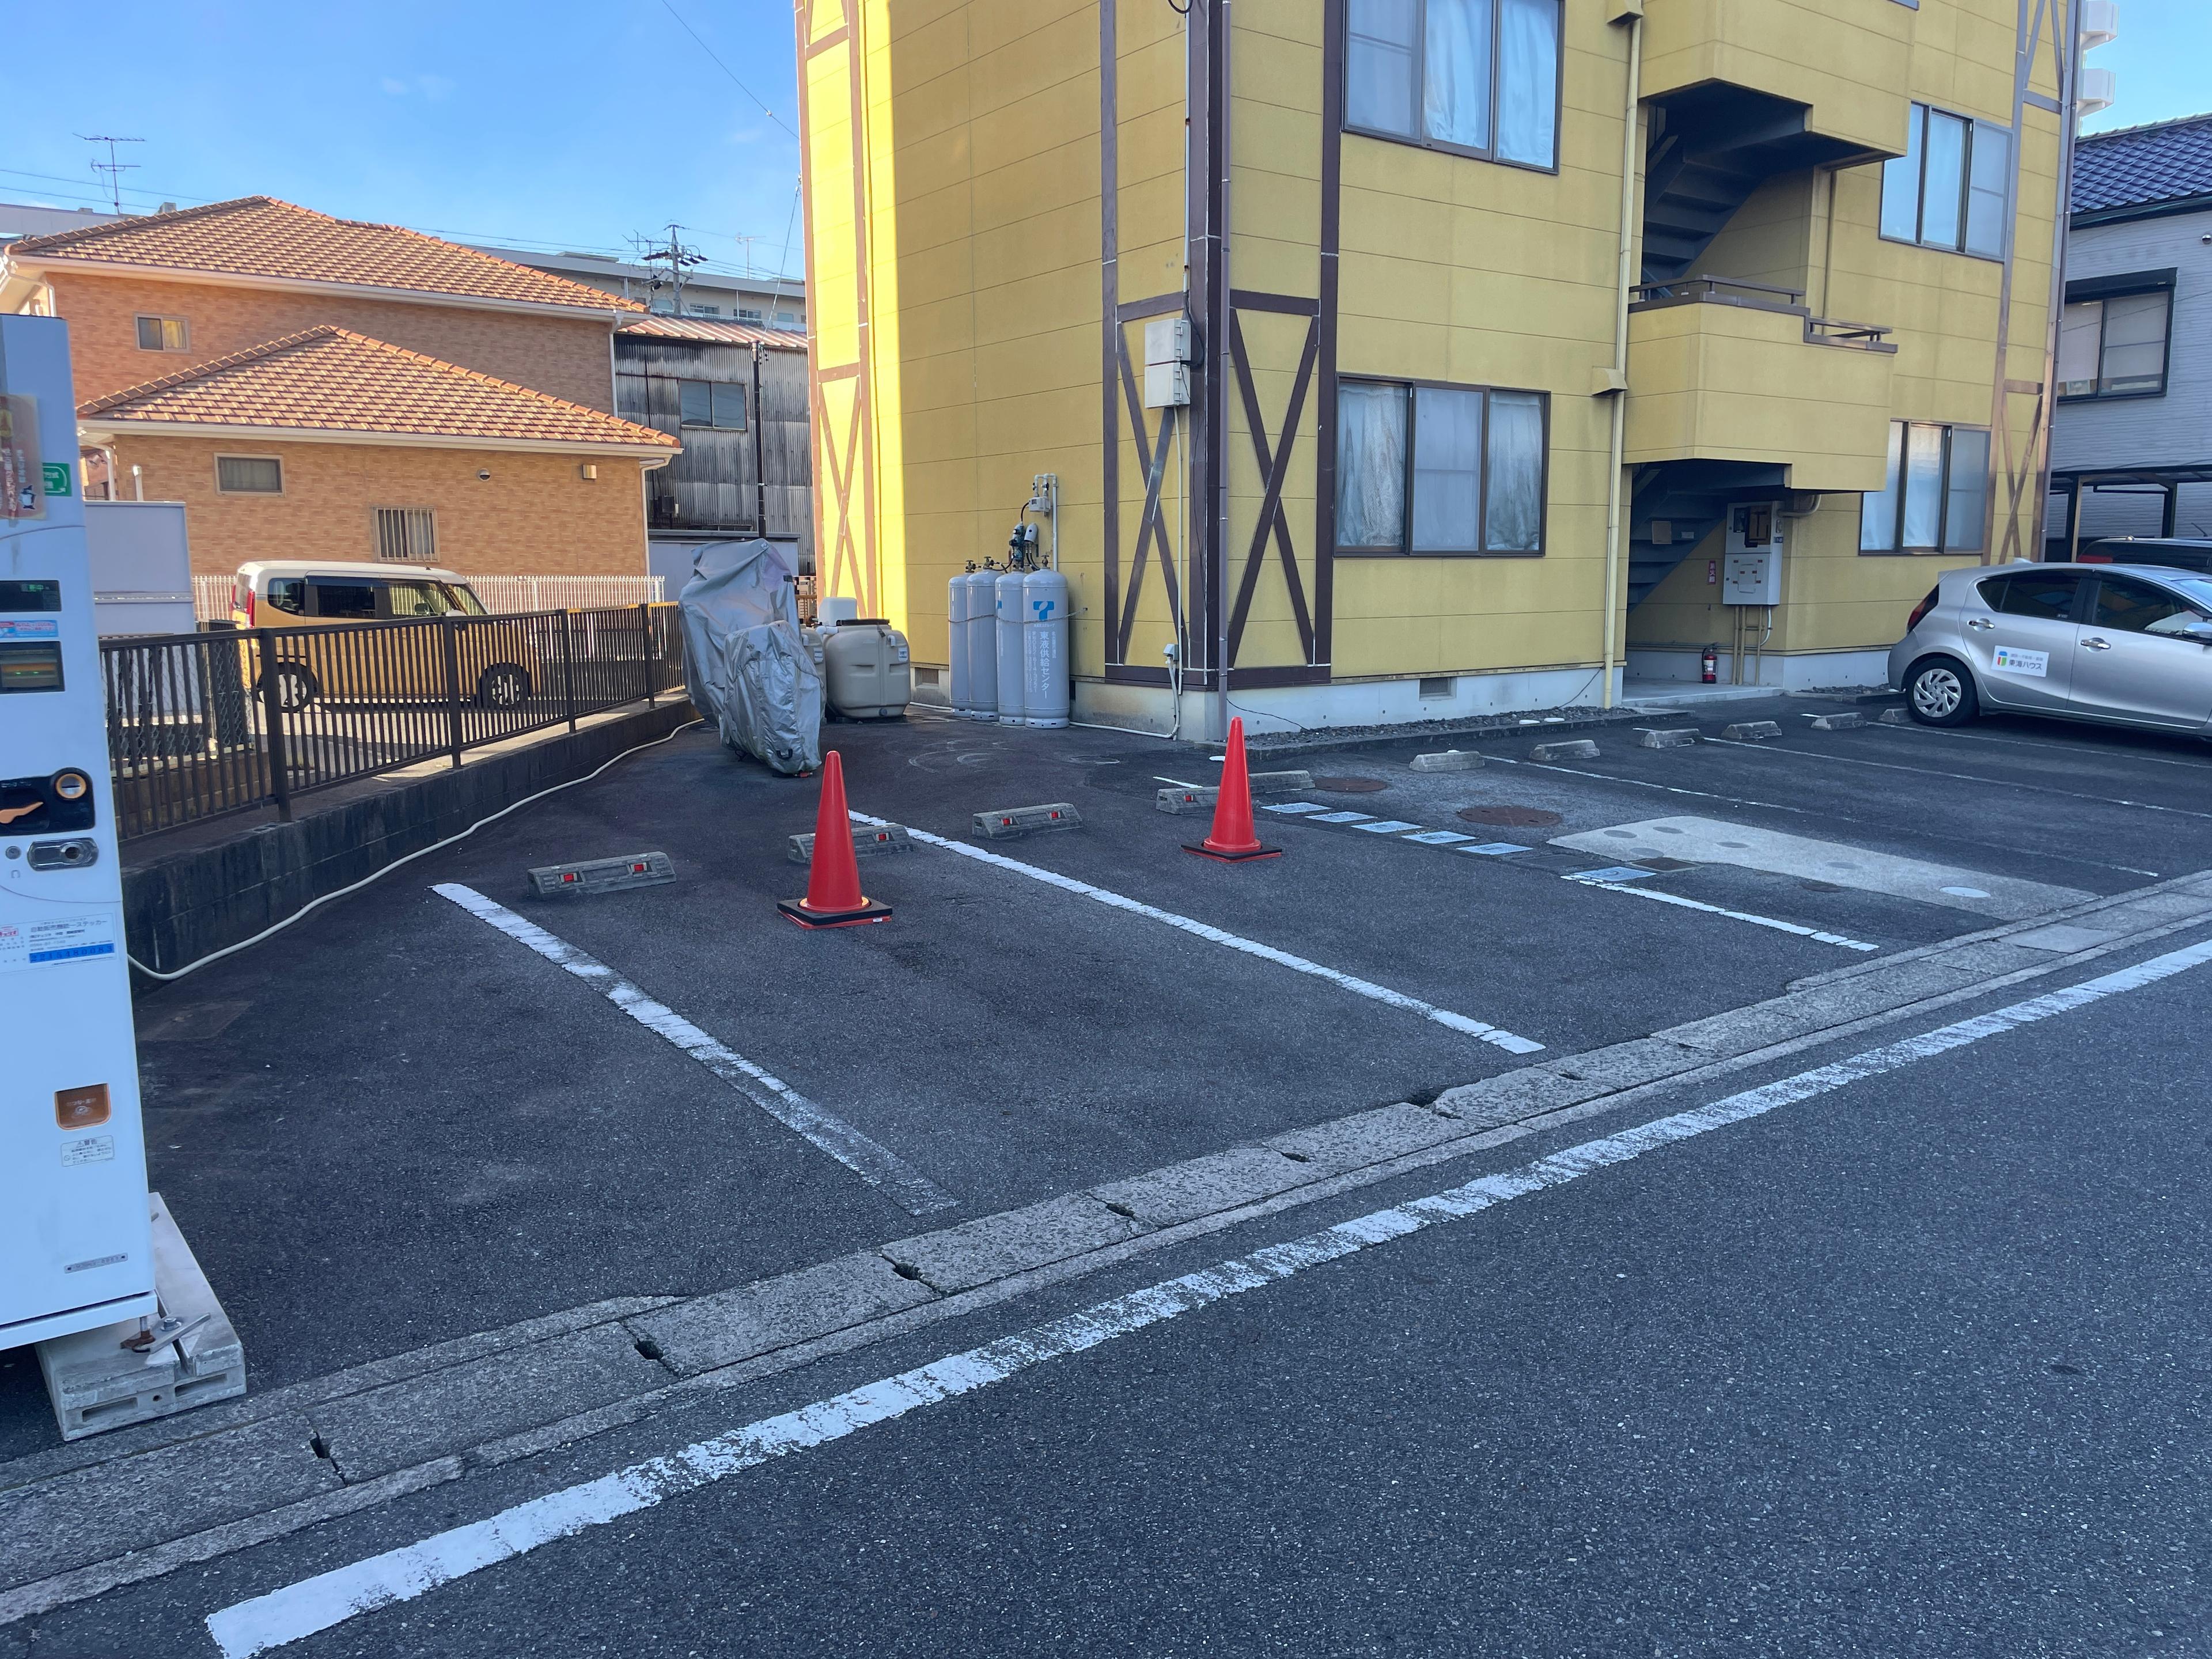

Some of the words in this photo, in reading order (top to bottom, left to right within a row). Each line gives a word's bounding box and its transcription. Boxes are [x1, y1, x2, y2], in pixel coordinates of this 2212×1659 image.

[1039, 631, 1050, 698] 東液供給センター
[2009, 659, 2042, 670] 東海ハウス
